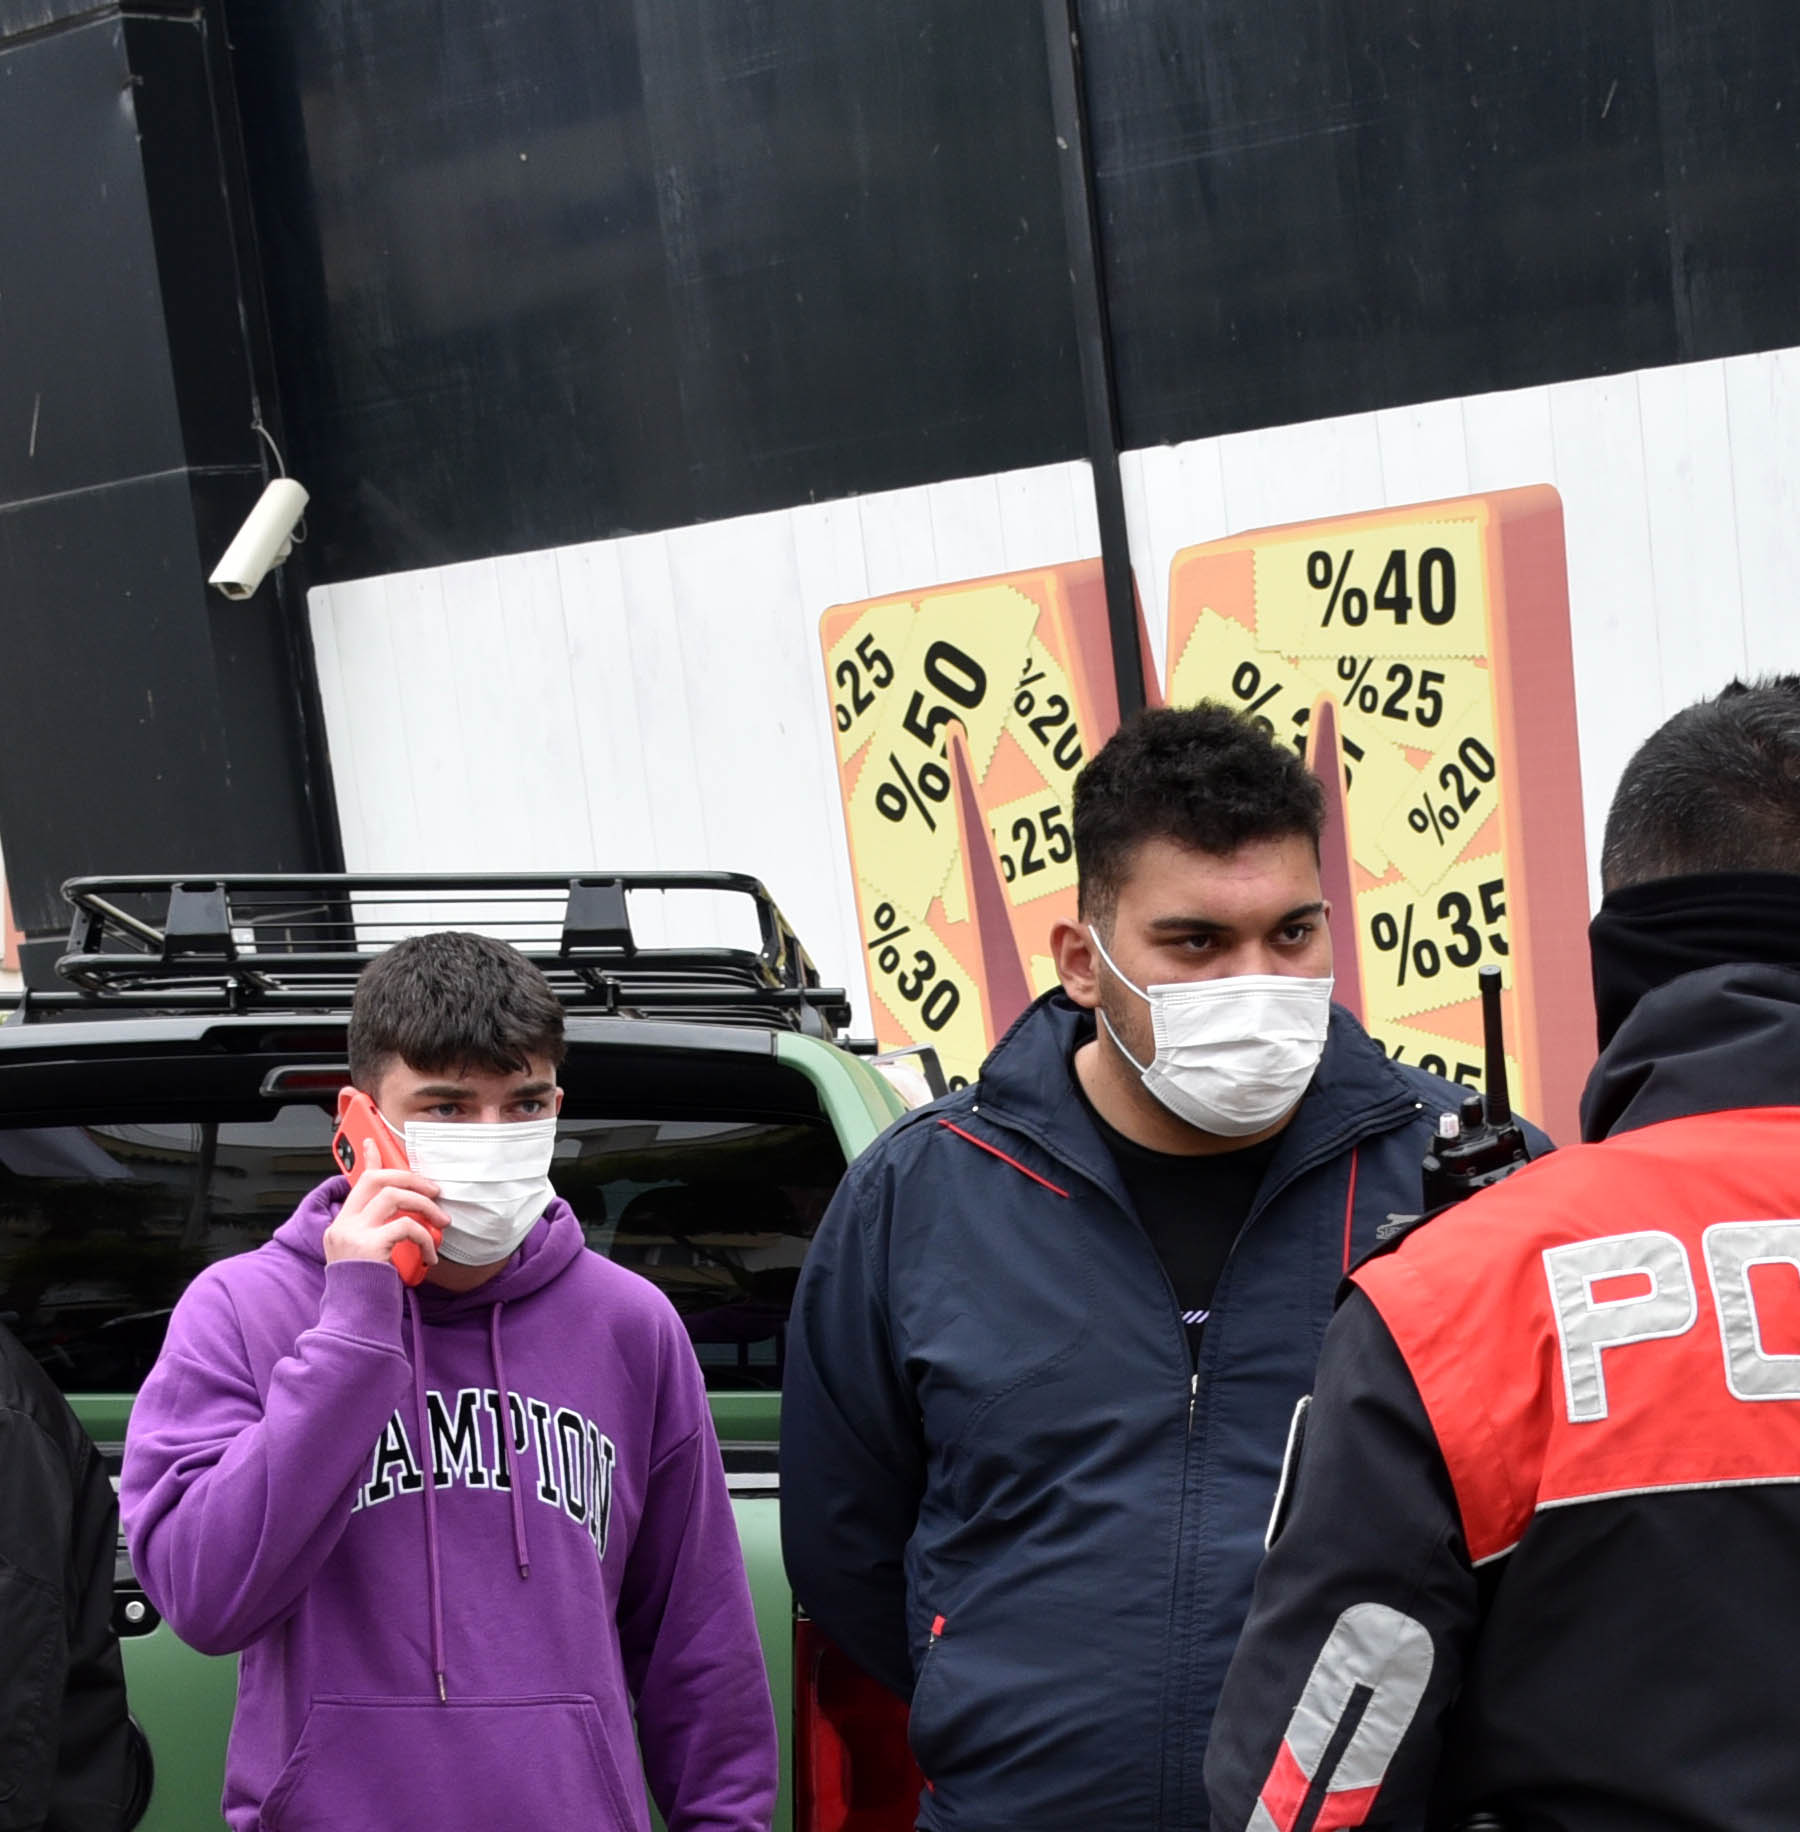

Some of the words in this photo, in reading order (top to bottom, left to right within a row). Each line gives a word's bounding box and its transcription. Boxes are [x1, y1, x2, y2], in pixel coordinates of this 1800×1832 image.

[1306, 547, 1457, 628] %40
[875, 640, 988, 834] %50
[1337, 656, 1446, 728] %25
[1408, 737, 1496, 846] %20
[868, 902, 960, 1032] %30
[1370, 878, 1510, 988] %35
[351, 1387, 616, 1562] AMPION
